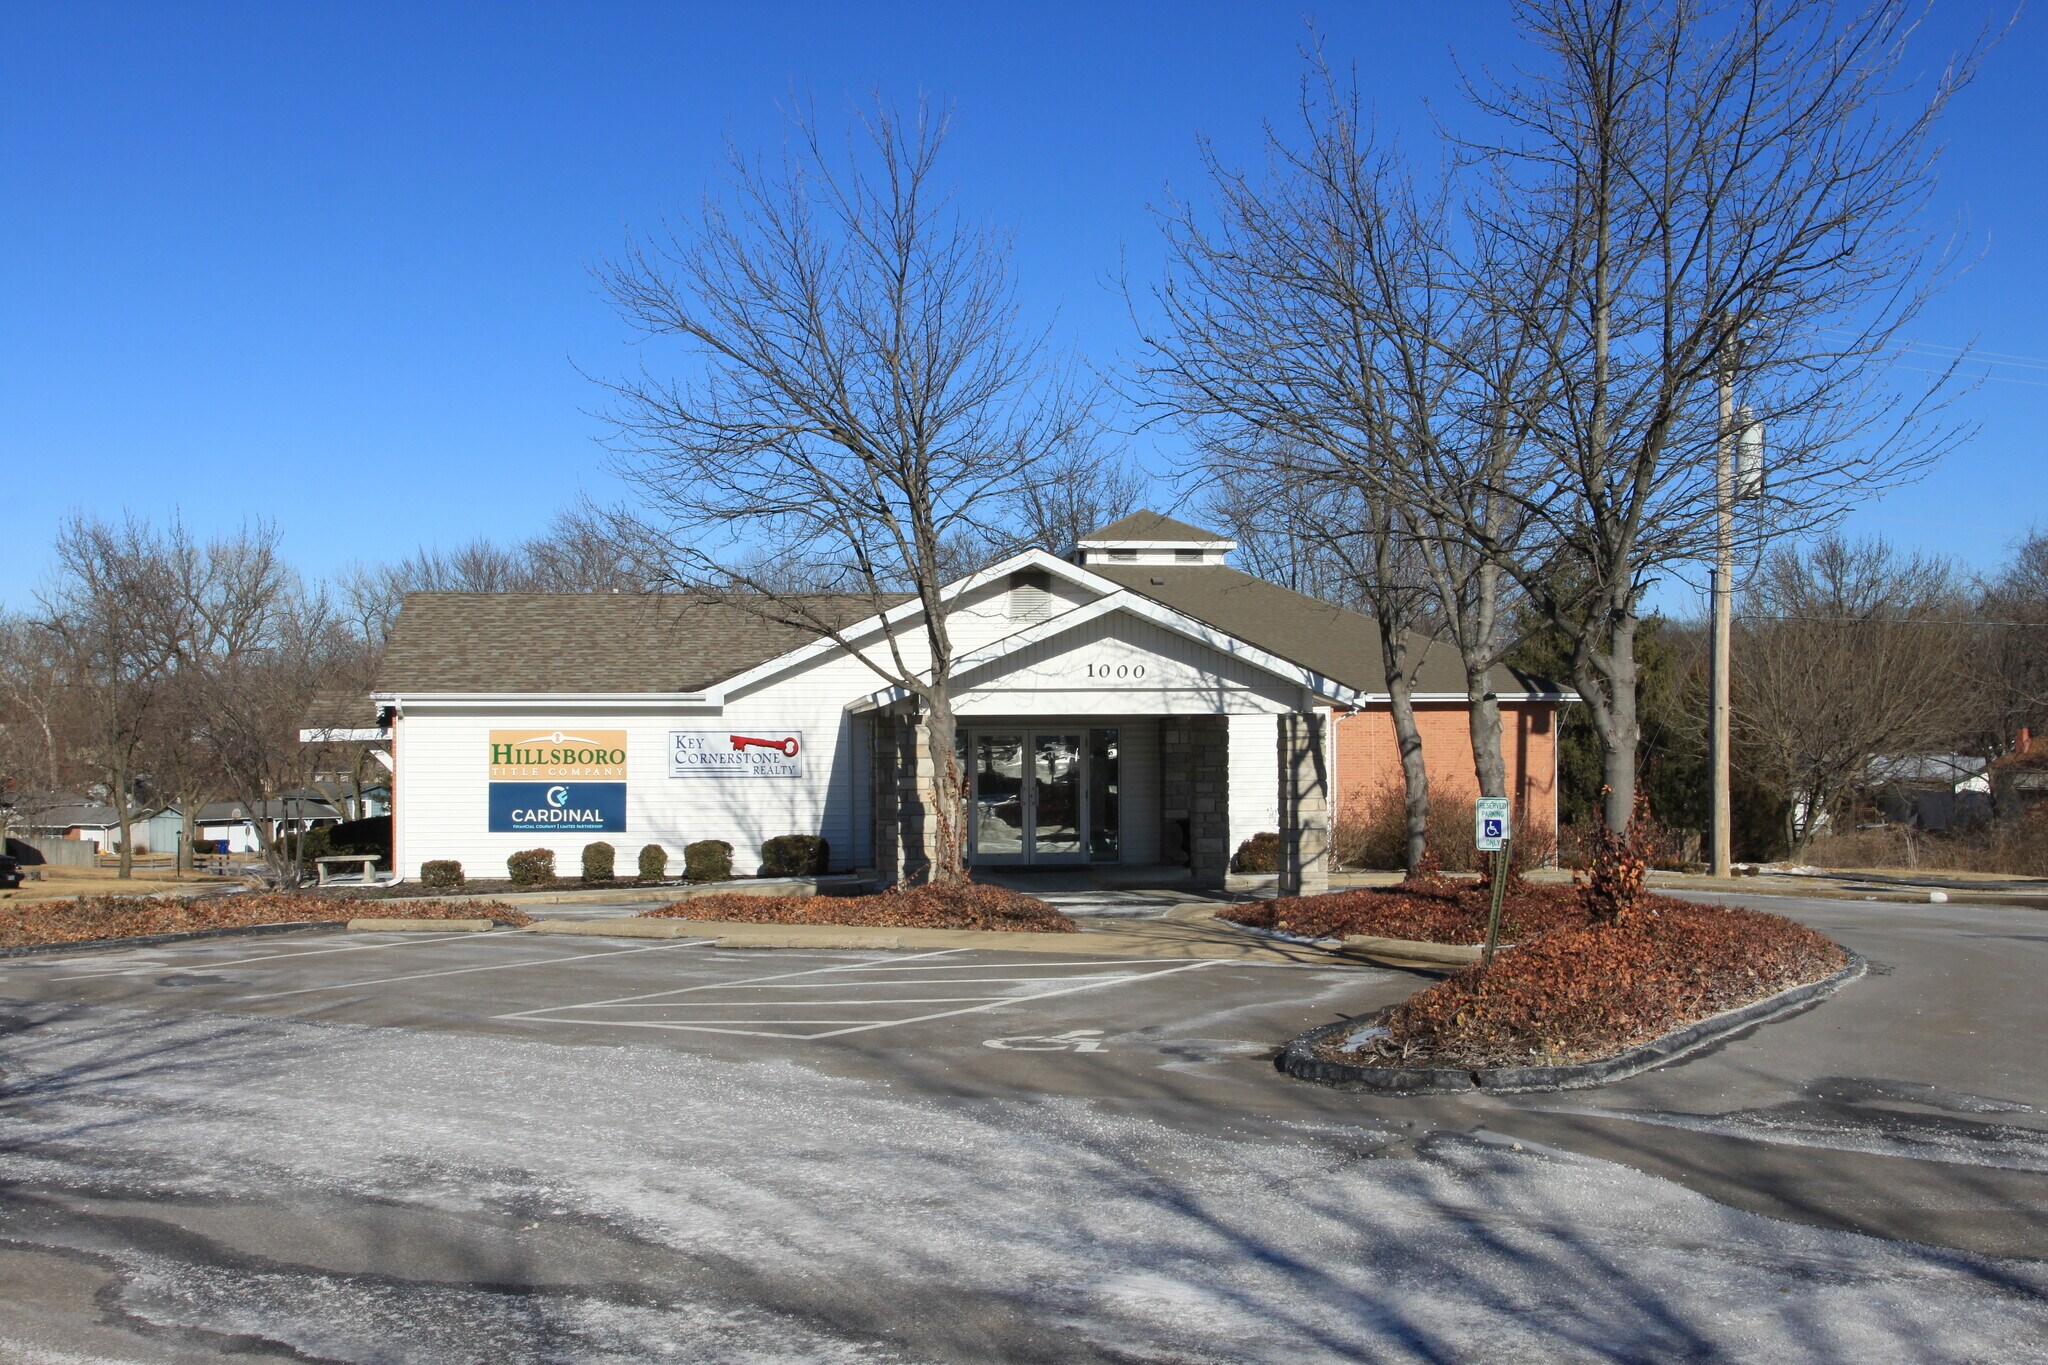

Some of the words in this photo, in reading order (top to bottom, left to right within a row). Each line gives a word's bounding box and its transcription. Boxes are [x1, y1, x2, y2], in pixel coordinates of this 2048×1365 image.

[1087, 663, 1145, 679] 1000
[675, 735, 705, 749] KEY
[491, 743, 626, 765] HILLSBORO
[675, 750, 780, 764] CORNERSTONE
[492, 767, 539, 776] TITLE
[548, 767, 624, 776] COMPANY
[753, 765, 796, 775] REALTY
[511, 809, 604, 822] CARDINAL
